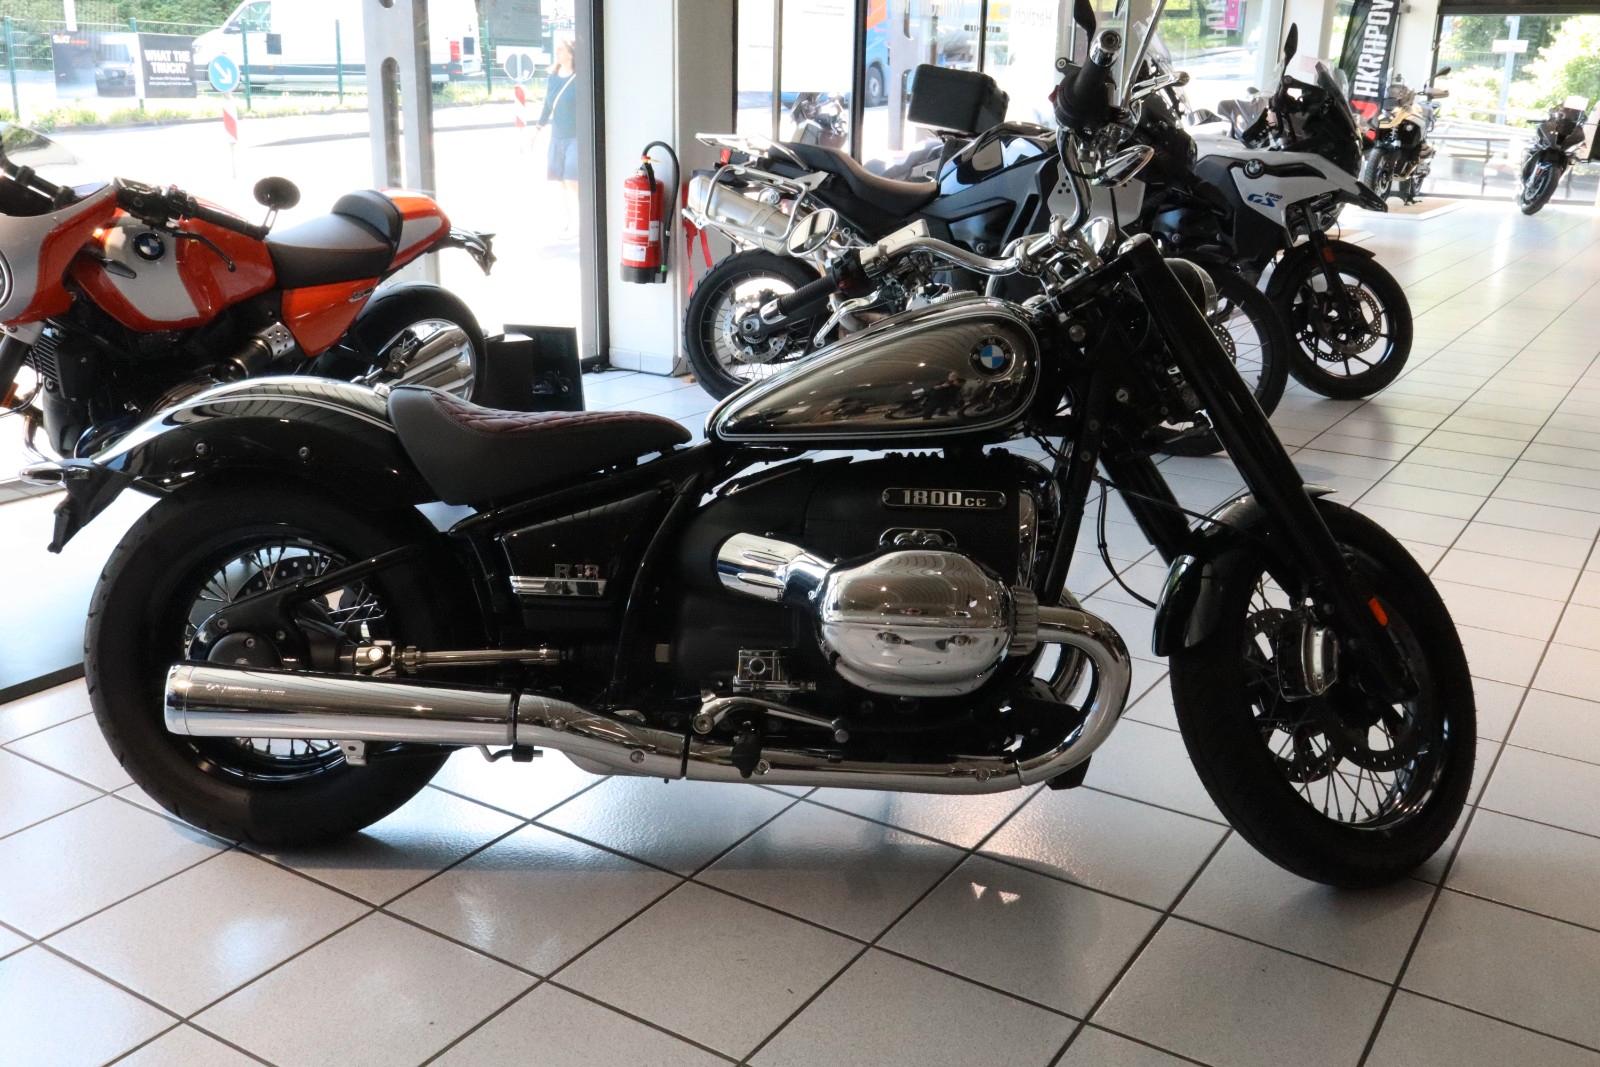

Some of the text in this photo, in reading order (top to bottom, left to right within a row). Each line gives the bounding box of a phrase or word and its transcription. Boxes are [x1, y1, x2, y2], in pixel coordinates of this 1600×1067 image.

[144, 49, 191, 62] WHAT THE
[1247, 193, 1278, 208] GS
